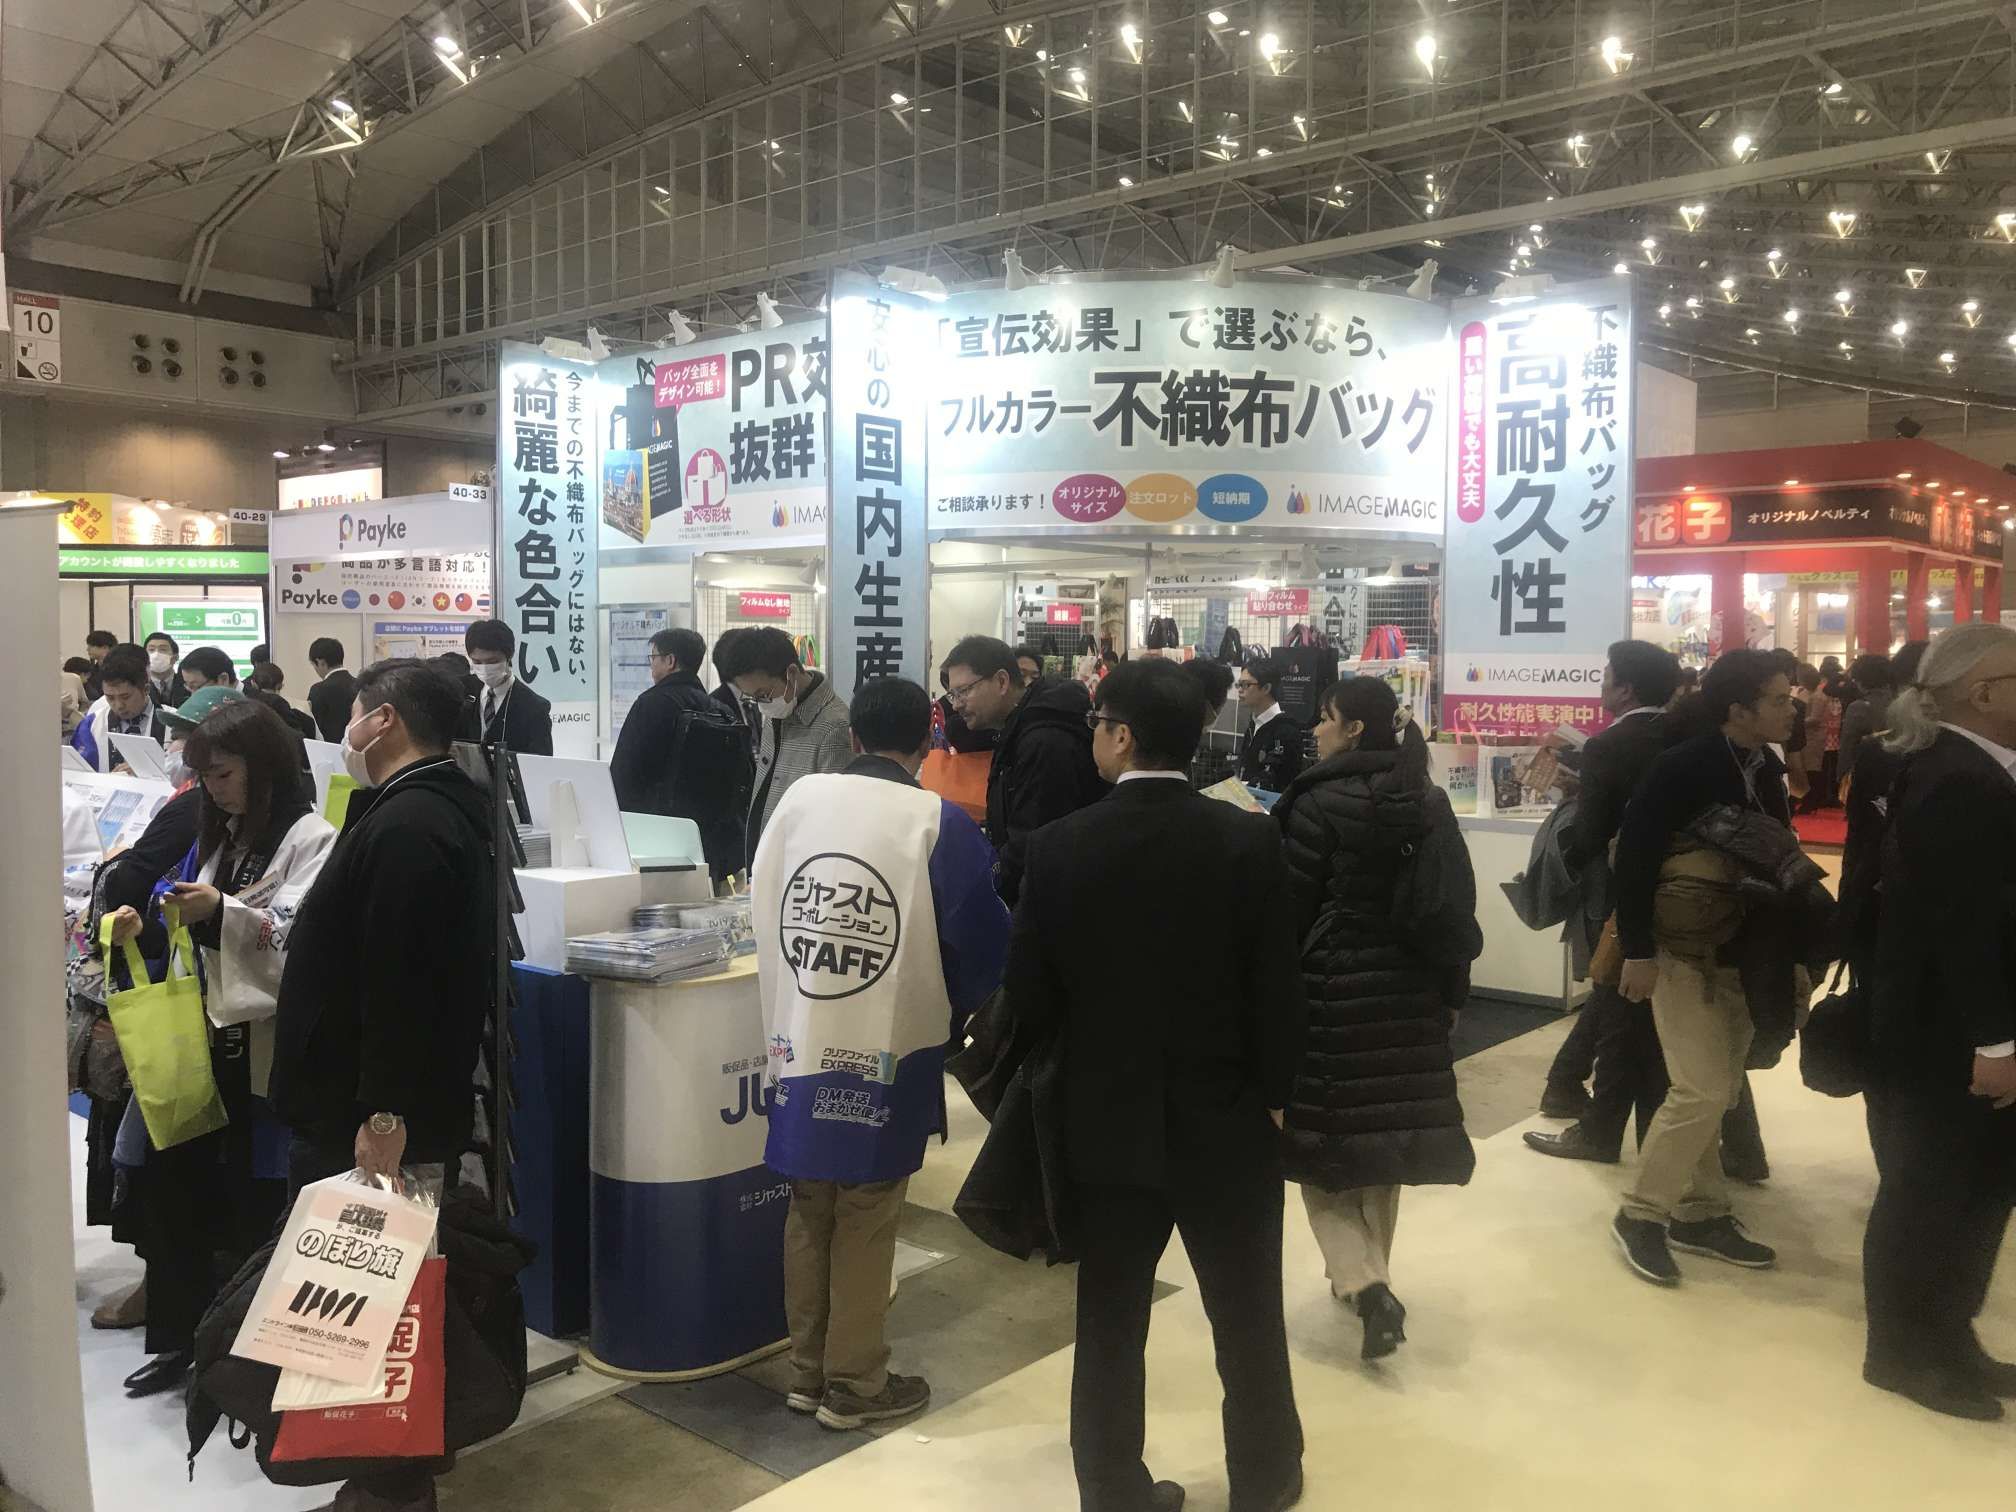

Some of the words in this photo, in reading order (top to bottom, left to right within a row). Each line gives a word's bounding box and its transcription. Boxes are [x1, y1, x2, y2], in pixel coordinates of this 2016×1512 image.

[24, 310, 53, 334] 10
[938, 307, 1387, 360] 「宣伝効果」で選ぶなら、
[664, 361, 718, 383] バッグ全面を
[659, 380, 720, 402] デザイン可能！
[941, 369, 1436, 454] フルカラー不織布バッグ
[1580, 304, 1618, 532] 不織布バッグ
[1490, 314, 1570, 636] 高耐久性
[453, 487, 487, 500] 40-33
[938, 493, 1044, 513] ご相談承ります！
[1058, 486, 1120, 500] オリジナル
[233, 511, 266, 522] 40-29
[684, 507, 731, 525] 選べる形状
[1071, 501, 1108, 514] サイズ
[1748, 507, 1871, 524] オリジナルノベルティ
[358, 514, 407, 548] Payke
[514, 368, 560, 684] 綺麗な色合い
[566, 371, 586, 684] 今までの不織布バッグにはない、
[1638, 501, 1725, 542] 花子
[282, 588, 338, 608] Payke
[1460, 702, 1604, 725] 耐久性能実演中！
[793, 877, 894, 915] ジャスト
[792, 906, 888, 936] コーポレーション
[790, 935, 884, 979] STAFF
[824, 1048, 879, 1064] クリアファイル
[821, 1059, 878, 1077] EXPRESS
[817, 1087, 870, 1105] DM発送
[755, 1183, 791, 1206] ジャスト
[297, 1228, 403, 1280] のぼり旗
